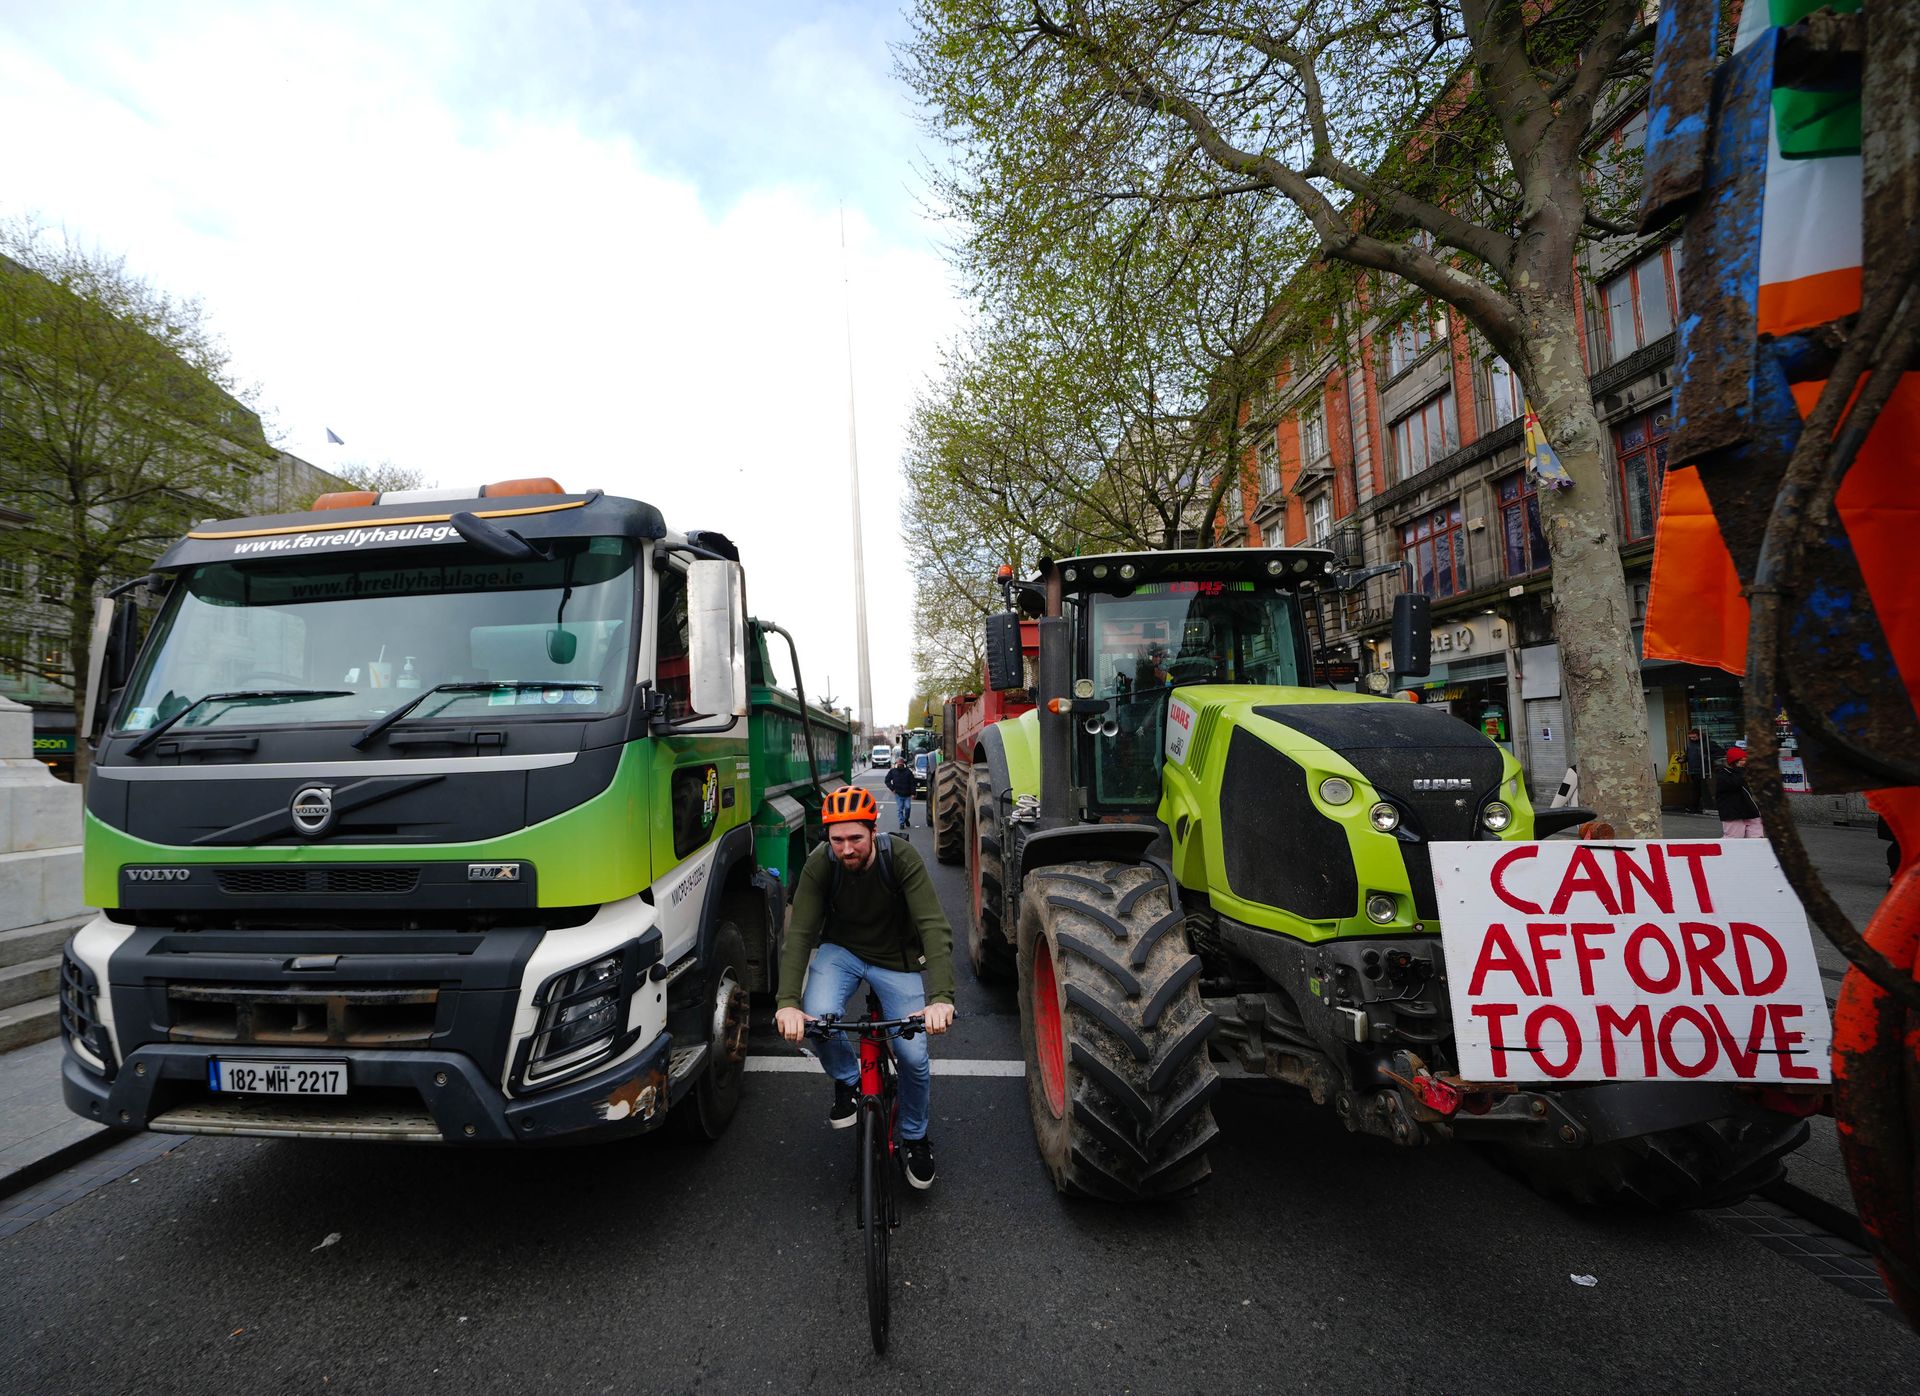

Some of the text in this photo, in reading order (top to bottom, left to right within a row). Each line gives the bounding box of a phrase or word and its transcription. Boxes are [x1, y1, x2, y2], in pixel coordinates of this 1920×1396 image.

[1163, 560, 1245, 573] AXION
[291, 567, 524, 598] www.farrellyhaulage.ie
[1426, 687, 1465, 703] SUBWAY
[1170, 703, 1191, 730] CLAAS
[1413, 778, 1472, 791] CLAAS
[293, 806, 330, 815] VOLVO
[126, 869, 190, 881] VOLVO
[469, 864, 519, 880] FMX
[1490, 843, 1722, 915] CANT
[1468, 922, 1788, 997] AFFORD
[1471, 1003, 1820, 1080] TO MOVE
[229, 1068, 340, 1093] 182-MH-2217
